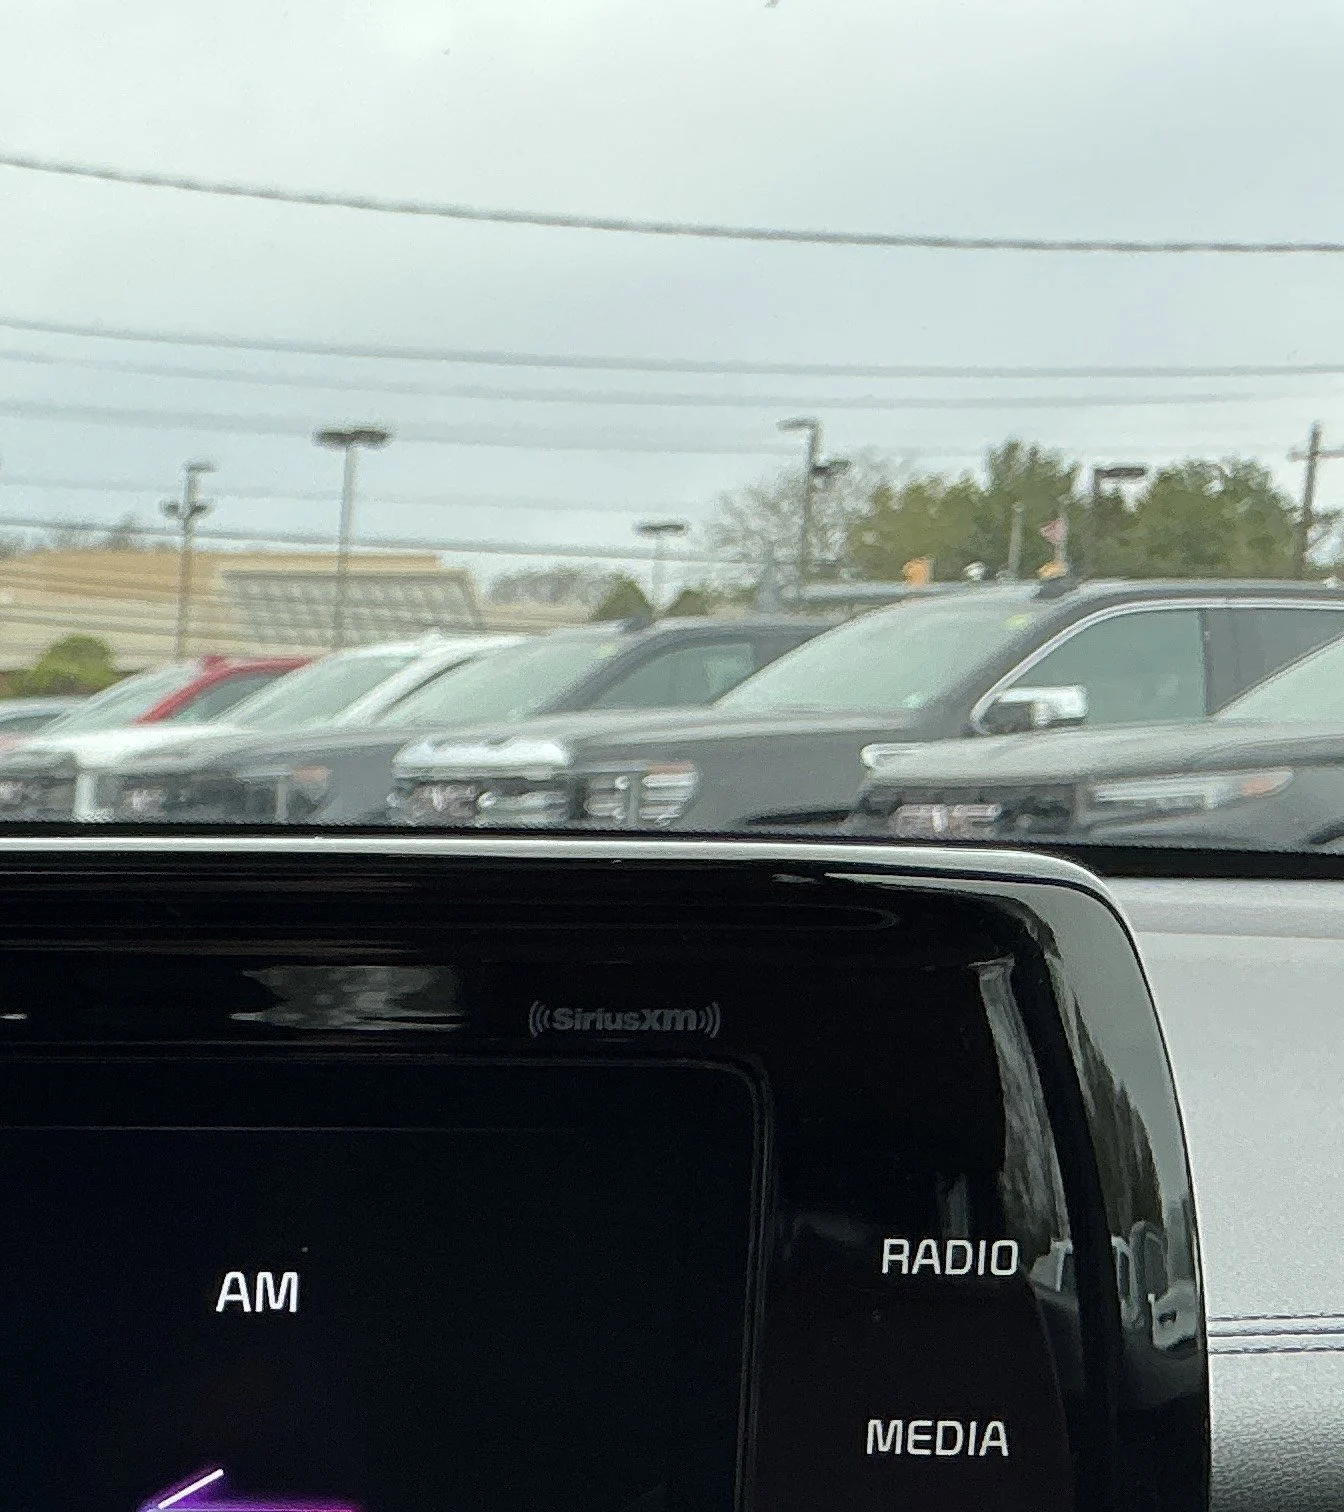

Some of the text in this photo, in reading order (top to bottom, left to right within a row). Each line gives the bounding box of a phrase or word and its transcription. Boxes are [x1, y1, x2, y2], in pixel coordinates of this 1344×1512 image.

[881, 1237, 1019, 1276] RADIO
[215, 1271, 300, 1313] AM
[866, 1419, 1010, 1457] MEDIA
